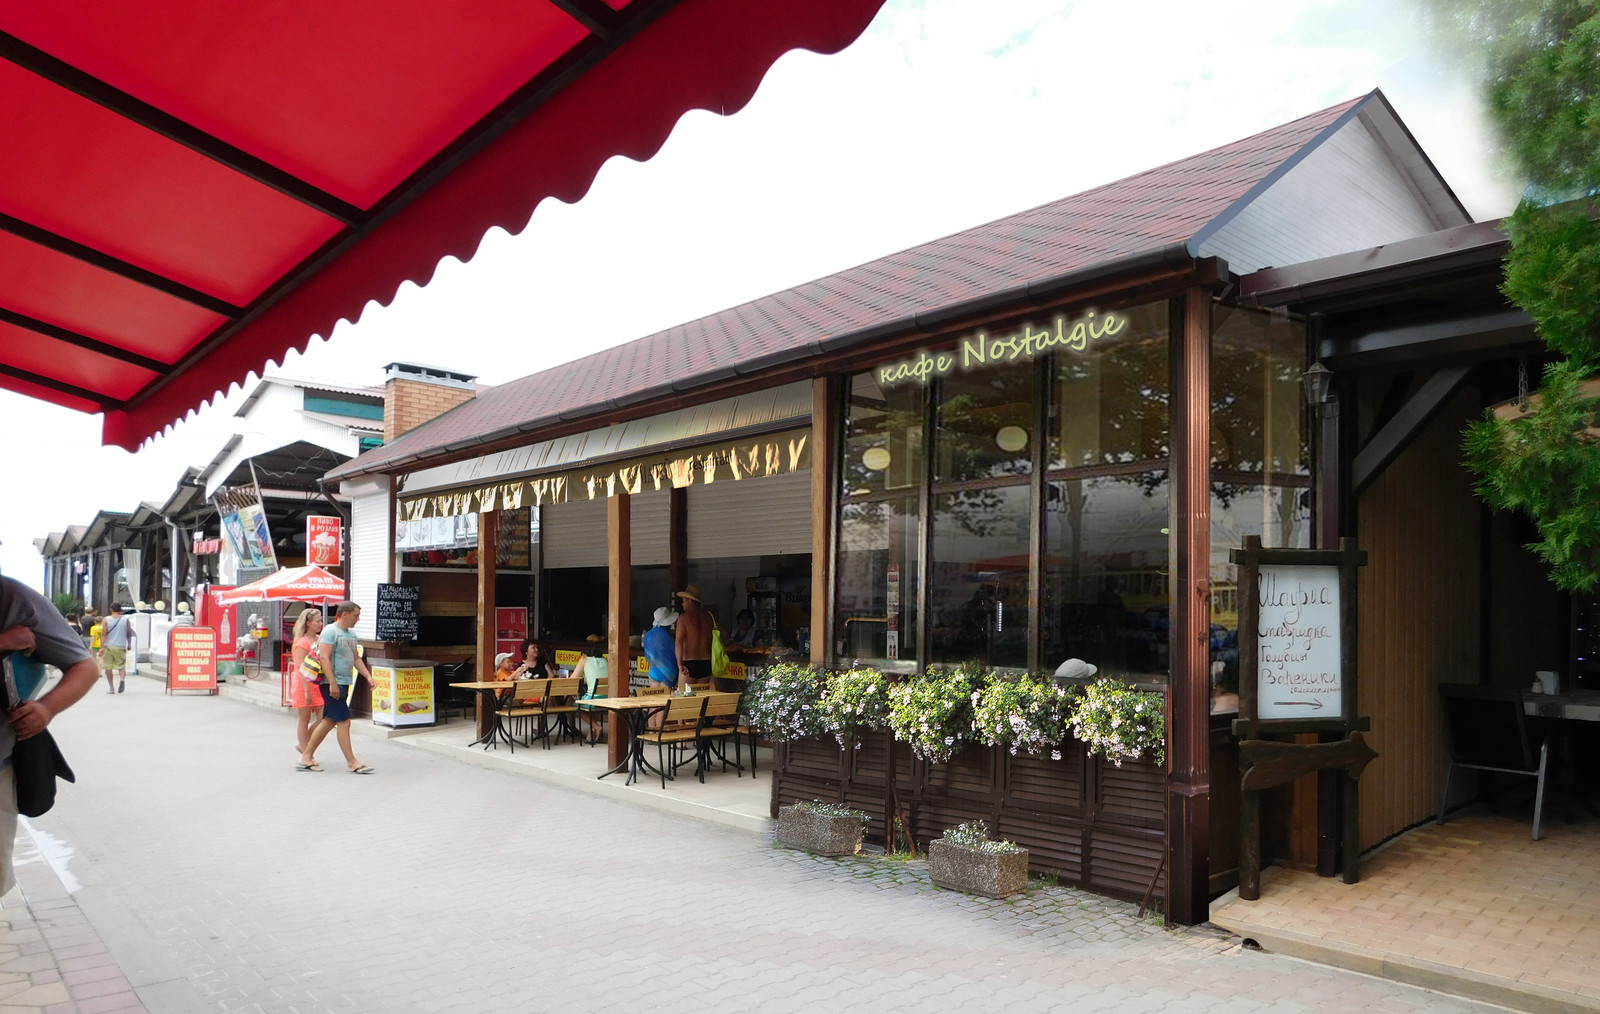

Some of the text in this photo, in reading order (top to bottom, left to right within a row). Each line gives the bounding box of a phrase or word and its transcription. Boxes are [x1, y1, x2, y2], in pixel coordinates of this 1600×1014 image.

[881, 311, 1126, 384] кафе Nostalgie
[307, 576, 334, 584] УРА!!!
